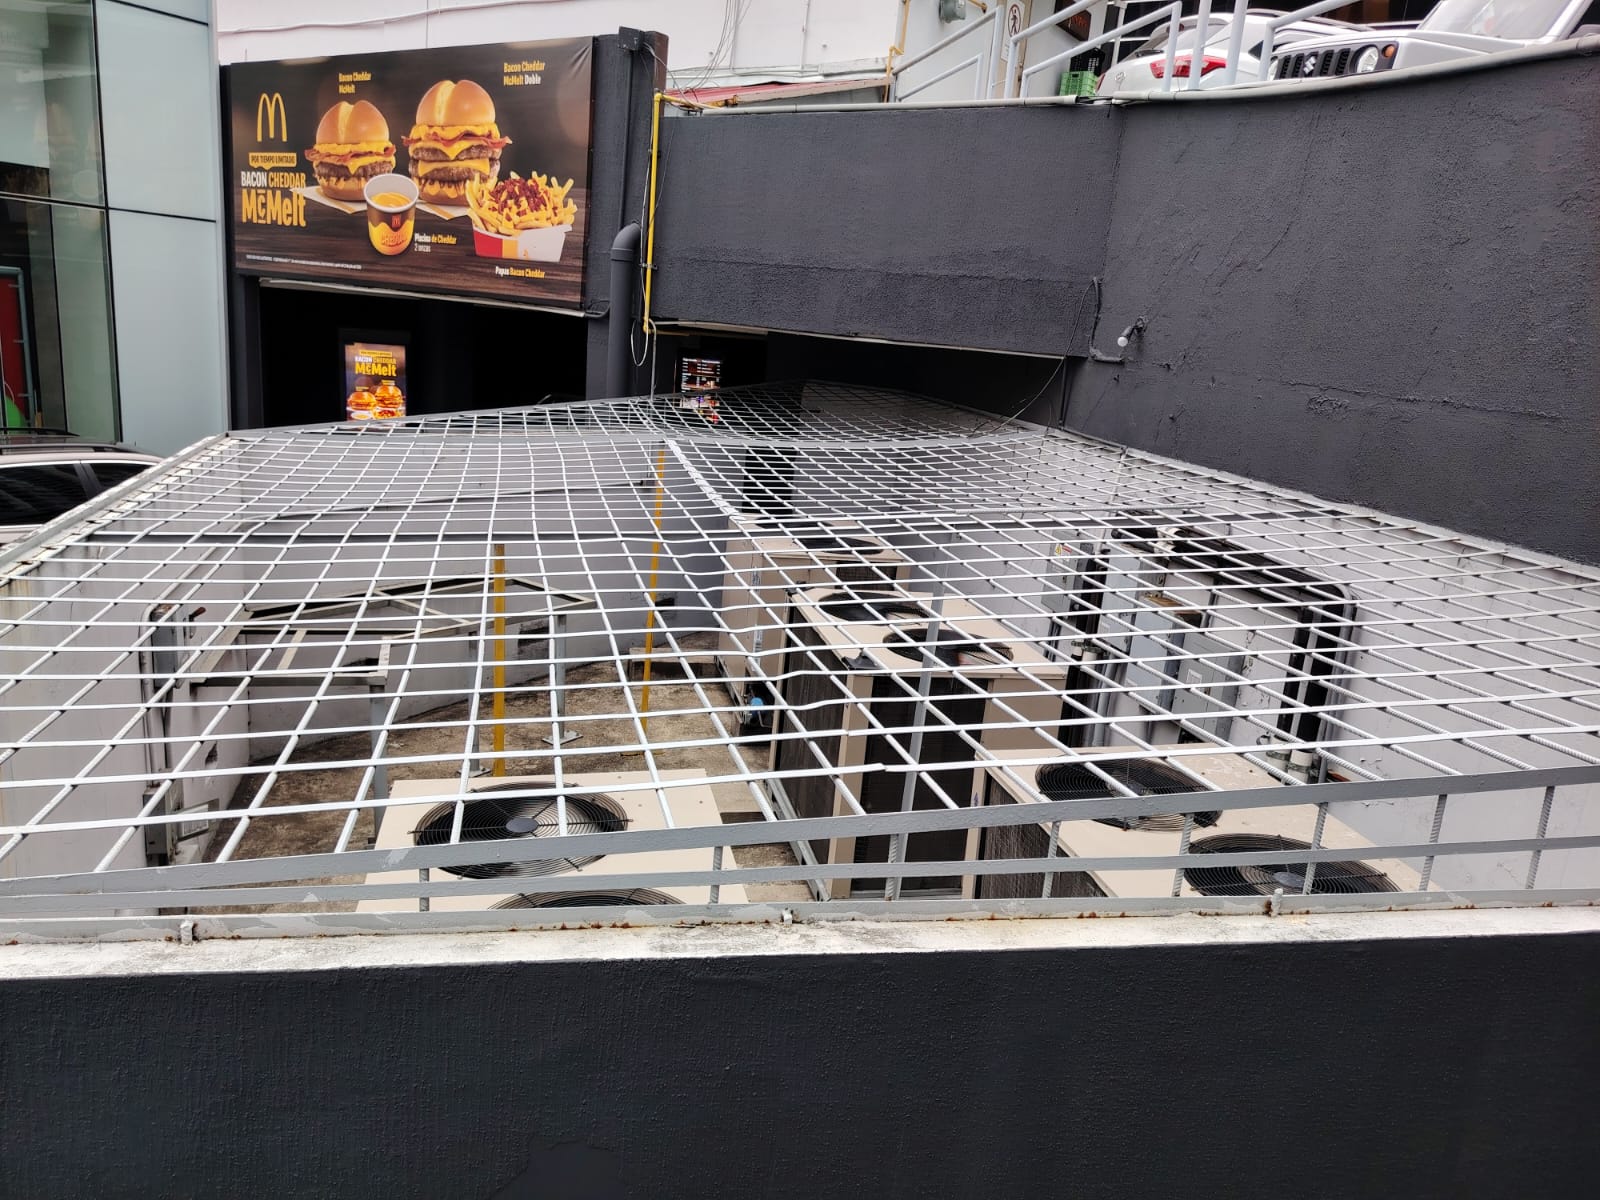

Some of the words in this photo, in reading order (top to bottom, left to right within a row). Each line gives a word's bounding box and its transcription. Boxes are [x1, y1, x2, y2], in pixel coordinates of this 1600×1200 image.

[240, 171, 267, 188] BACON
[268, 171, 306, 189] CHEDDAR
[241, 188, 307, 228] McMelt
[355, 362, 397, 377] McMelt
